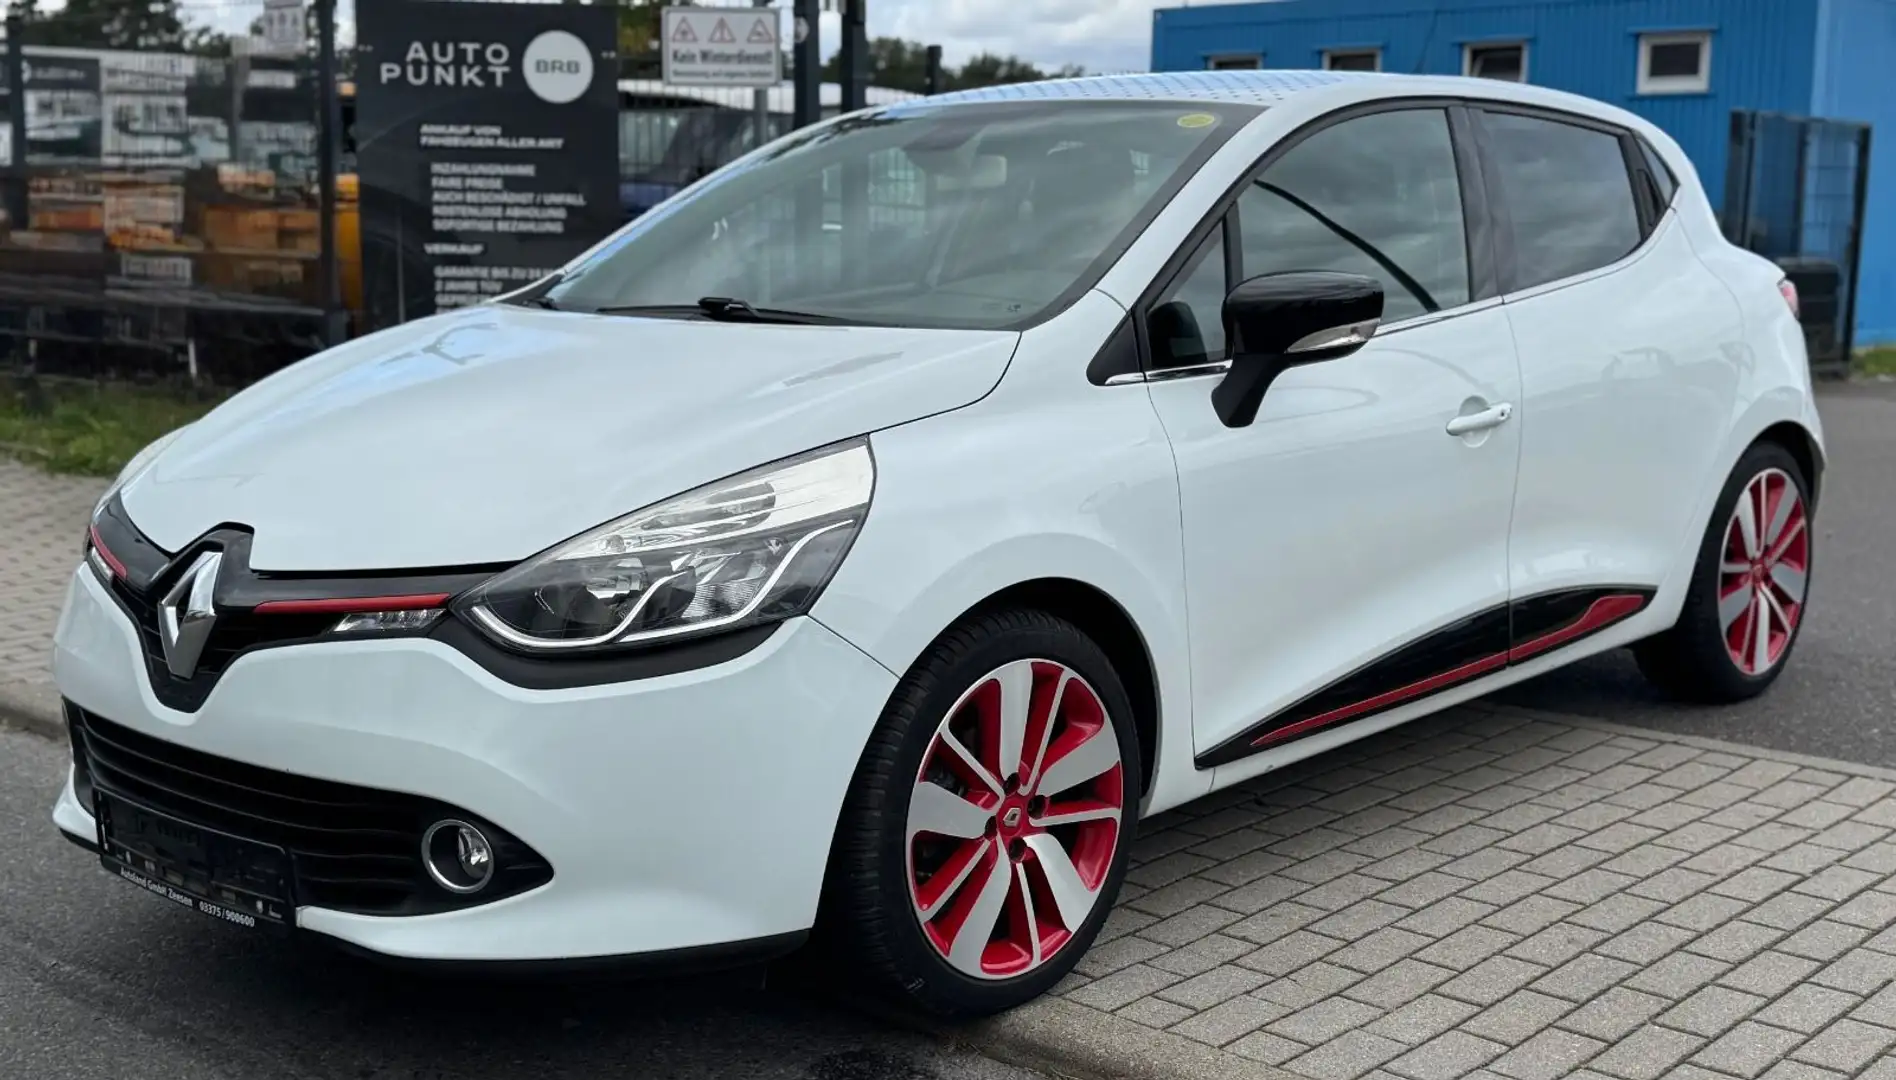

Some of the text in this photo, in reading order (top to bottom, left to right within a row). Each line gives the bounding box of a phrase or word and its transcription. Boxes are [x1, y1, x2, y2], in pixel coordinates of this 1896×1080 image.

[405, 41, 510, 64] AUTO
[672, 49, 697, 65] Kein
[535, 59, 581, 75] BRB
[380, 63, 511, 87] PUNKT
[420, 123, 502, 136] ANKAUF VON
[431, 176, 503, 190] FAIRE PREISE
[432, 190, 463, 203] AUCH
[543, 192, 587, 206] UNFALL
[432, 204, 567, 219] KOSTENLOSE ABHOLUNG
[432, 218, 564, 233] SOFORTIGE BEZAHLUNG
[423, 242, 485, 255] VERKAUF
[434, 265, 489, 279] GARANTIE
[491, 266, 510, 279] BIS
[510, 266, 527, 280] ZU
[479, 280, 503, 294] TÜV
